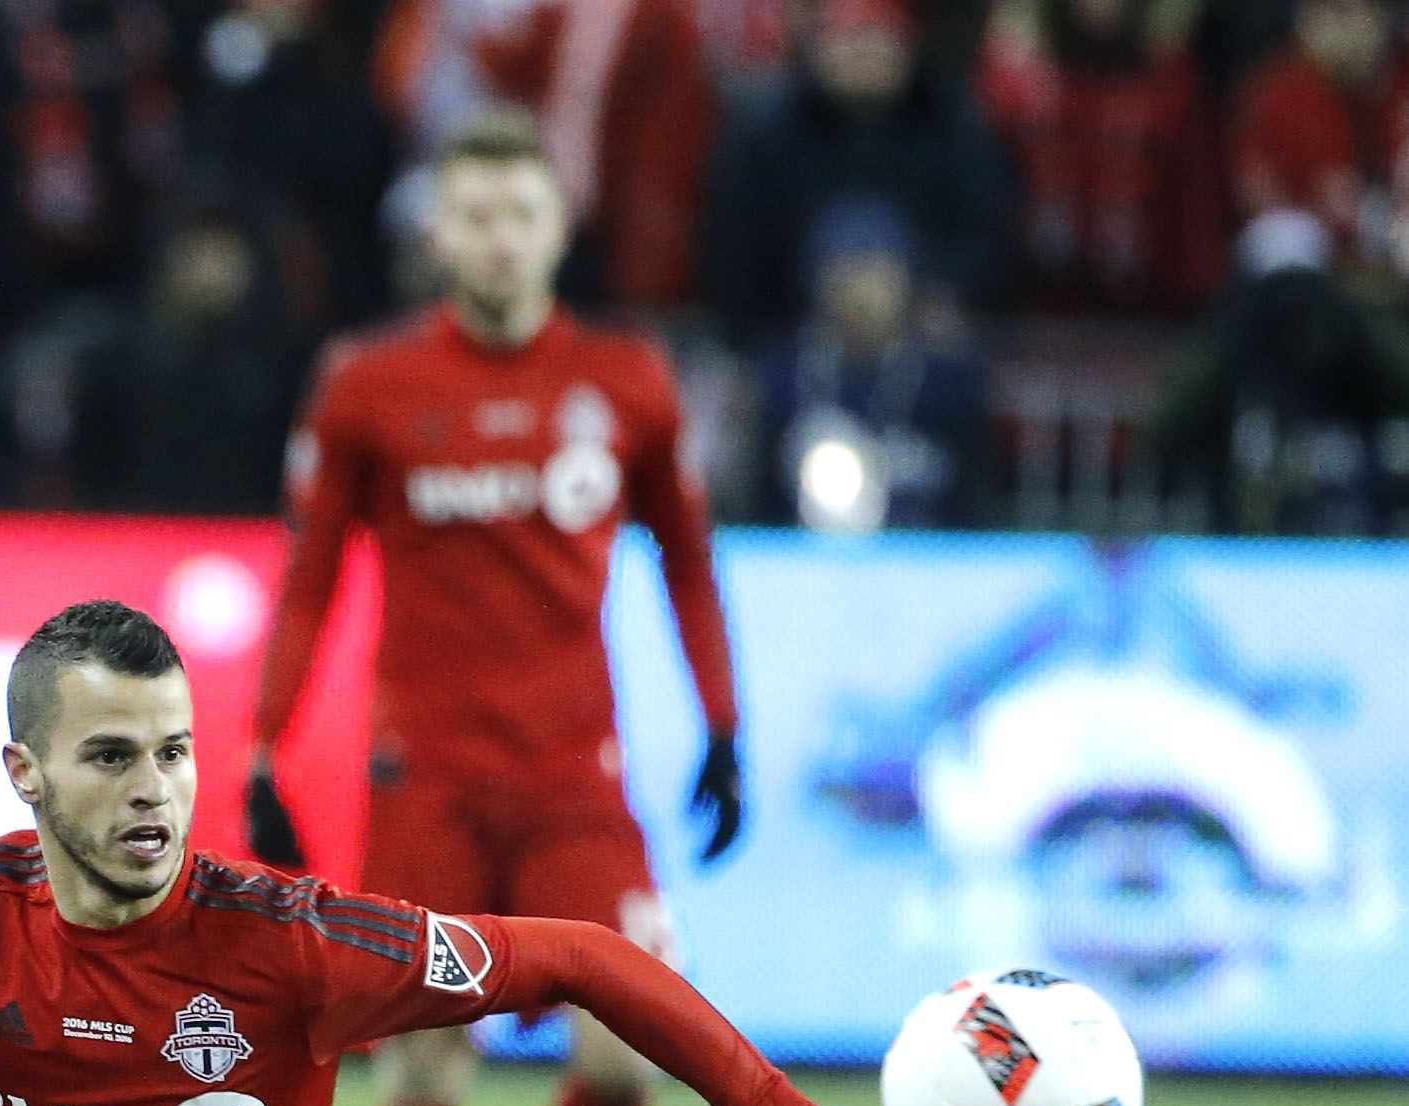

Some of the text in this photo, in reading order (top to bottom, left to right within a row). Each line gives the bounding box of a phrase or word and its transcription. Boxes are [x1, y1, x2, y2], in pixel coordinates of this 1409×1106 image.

[430, 943, 448, 982] MLS
[62, 1017, 135, 1035] 2016 MLS CUP
[175, 1035, 237, 1048] TORONTO
